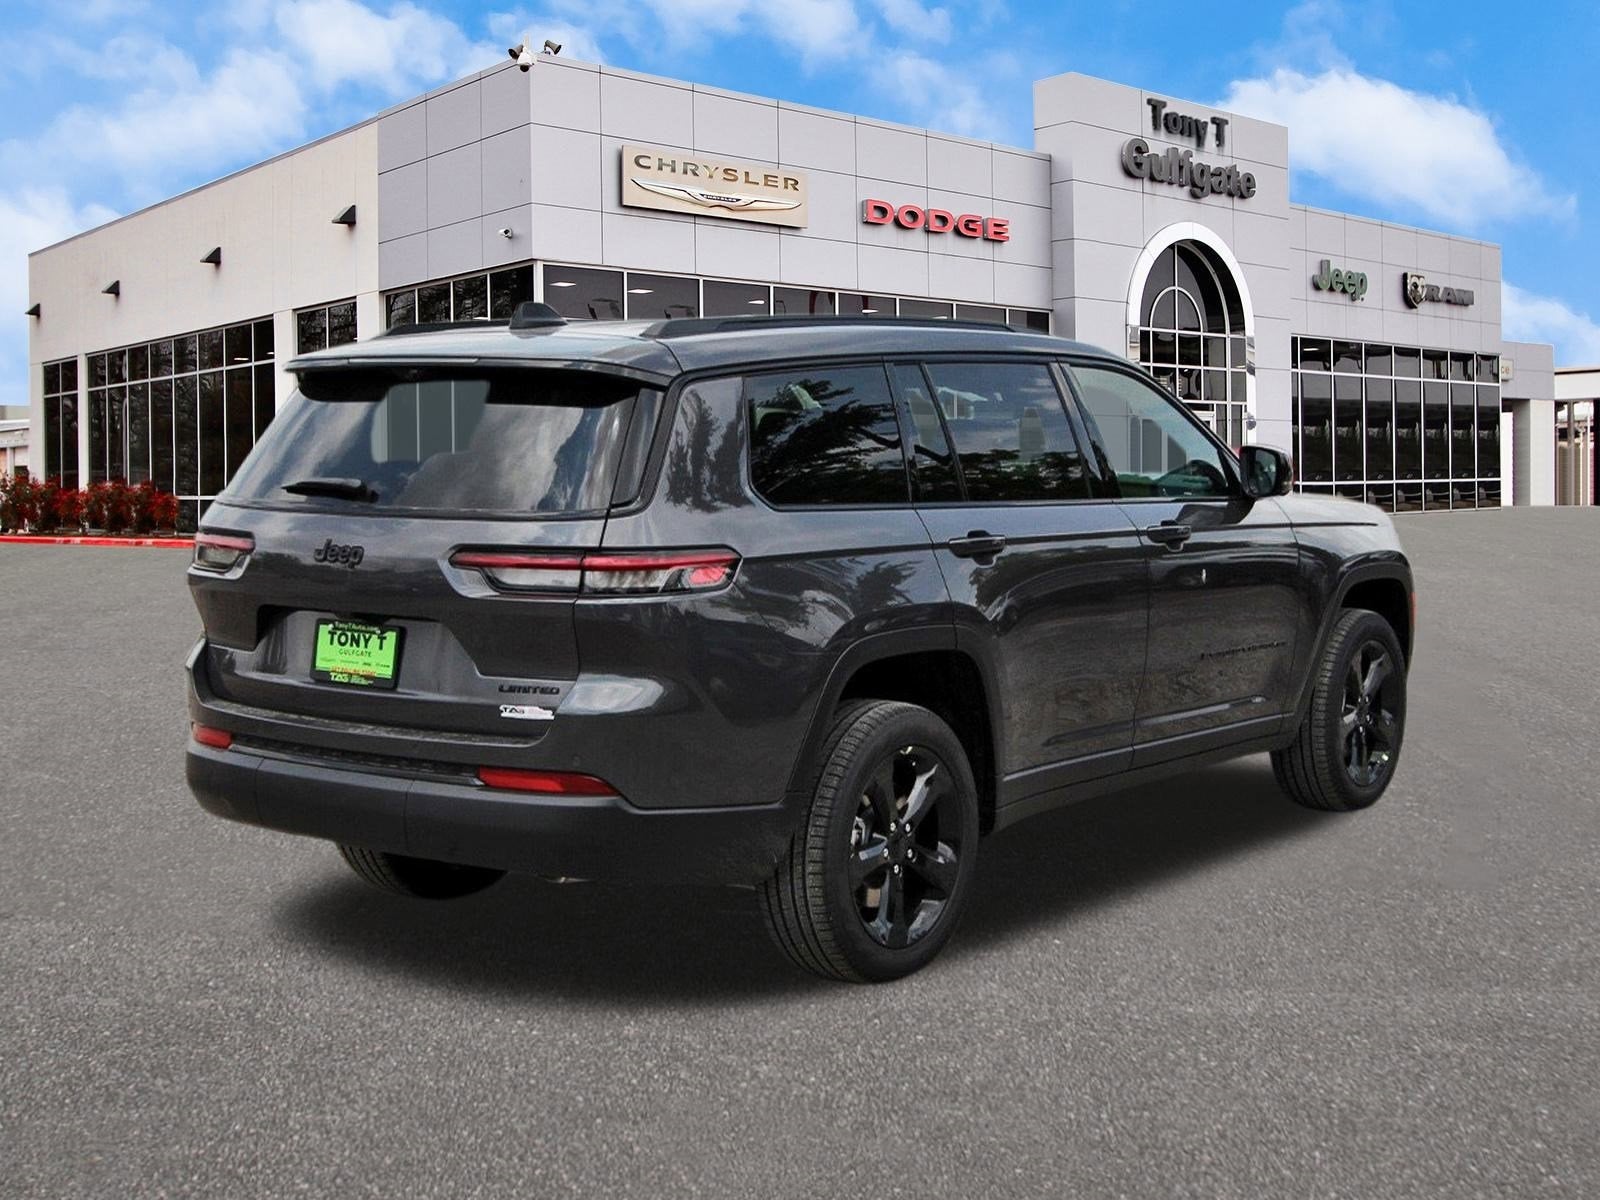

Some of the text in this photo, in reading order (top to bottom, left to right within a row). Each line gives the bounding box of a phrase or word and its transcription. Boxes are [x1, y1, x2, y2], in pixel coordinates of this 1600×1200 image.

[1147, 98, 1229, 147] Tony T
[633, 153, 801, 192] CHRYSLER
[1121, 138, 1256, 199] Gulfgate
[862, 198, 1011, 242] DODGE
[1312, 259, 1369, 301] Jeep
[1424, 283, 1475, 307] RAM
[314, 538, 365, 569] Jeep
[328, 630, 388, 651] TONY T
[498, 685, 560, 695] LIMITED
